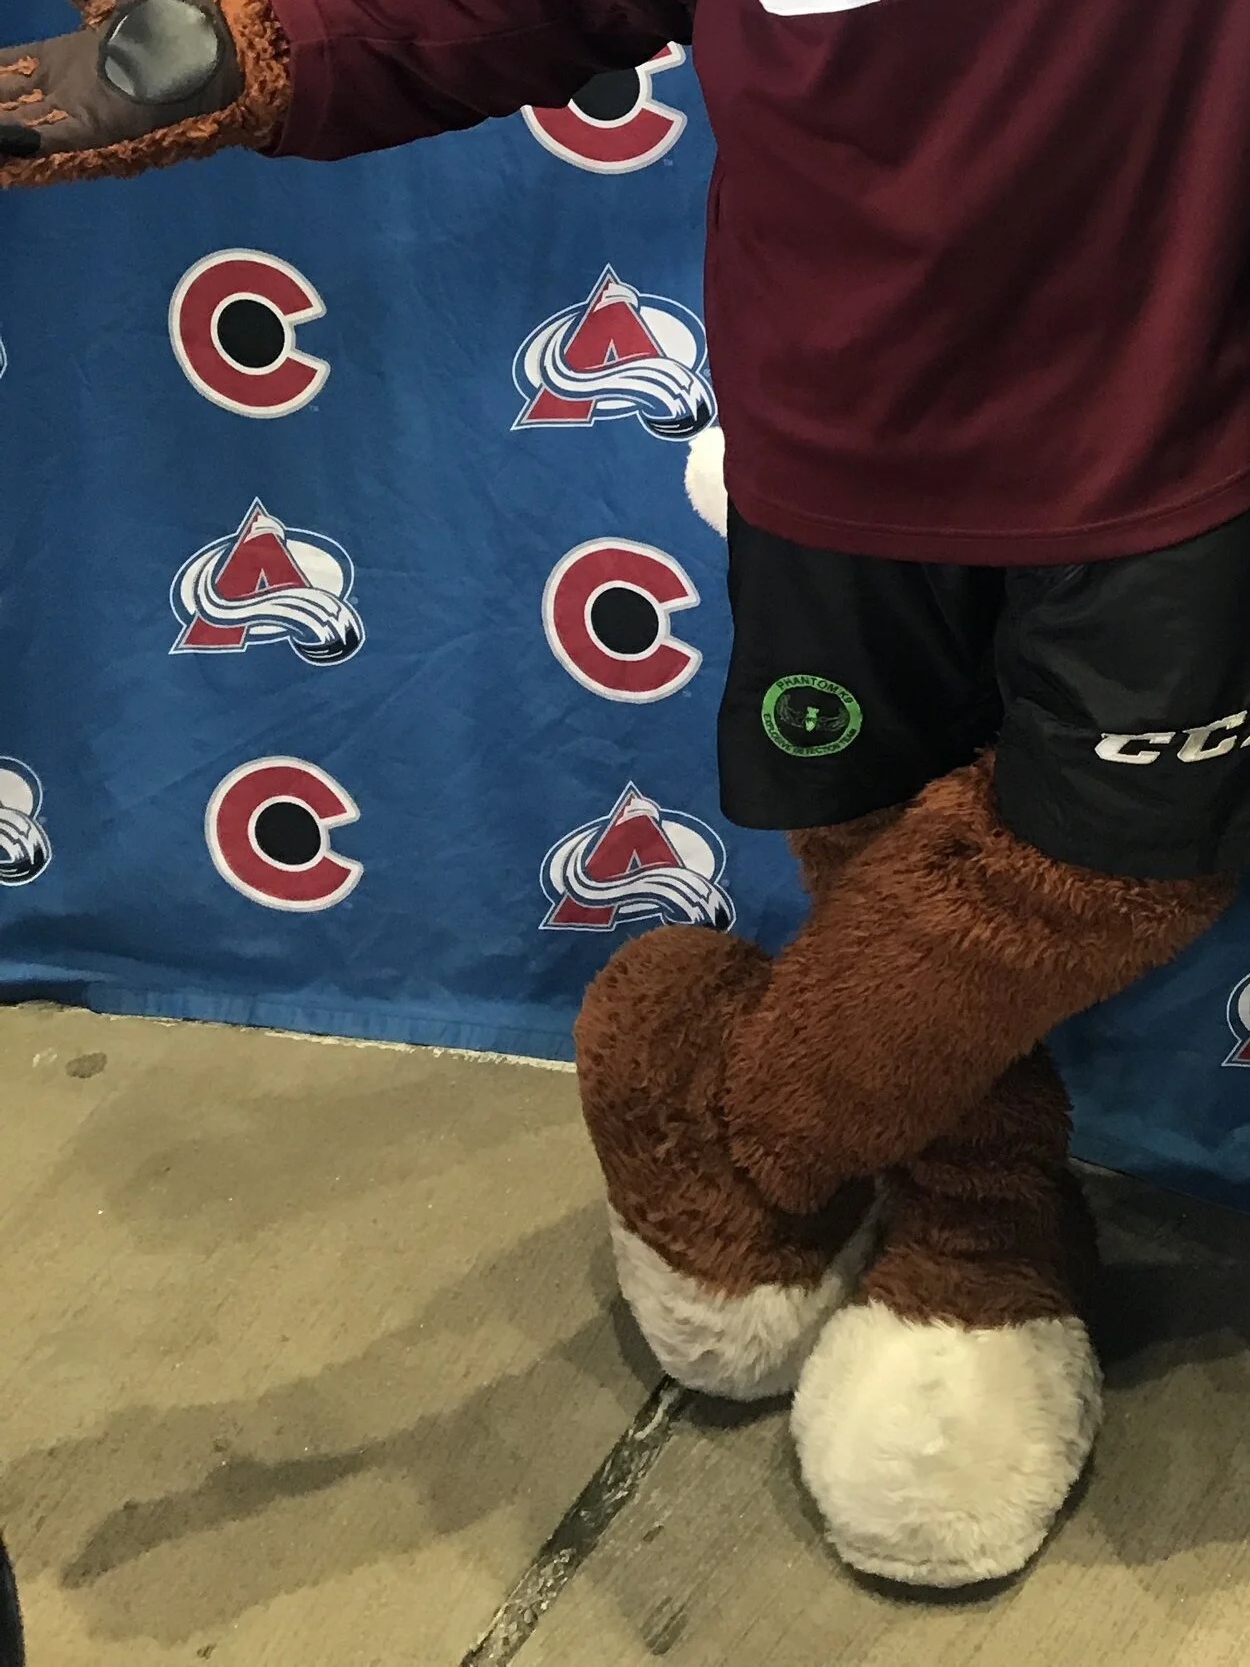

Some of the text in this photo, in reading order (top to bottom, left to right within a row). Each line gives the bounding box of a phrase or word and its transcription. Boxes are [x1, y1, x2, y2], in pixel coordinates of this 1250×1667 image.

[168, 247, 330, 419] C
[541, 537, 703, 704] C
[776, 676, 839, 693] PHANTOM
[205, 755, 364, 913] C
